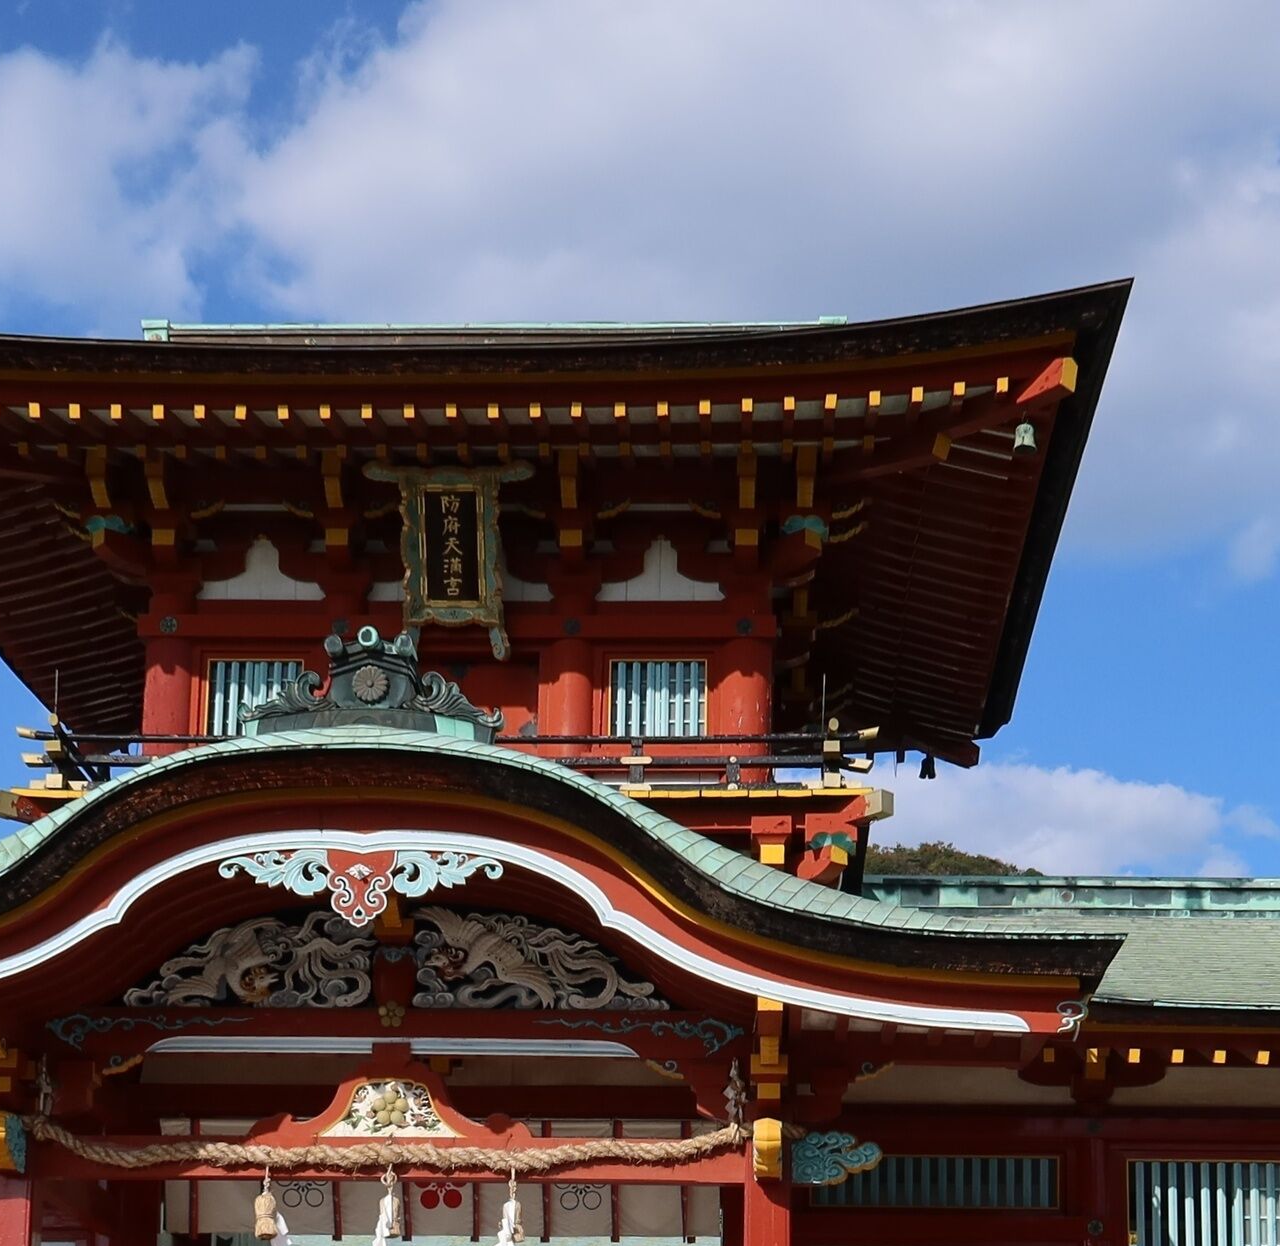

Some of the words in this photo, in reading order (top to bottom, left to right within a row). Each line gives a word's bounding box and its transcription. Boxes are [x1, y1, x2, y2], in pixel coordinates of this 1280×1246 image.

[440, 495, 463, 596] 防府天満宮
